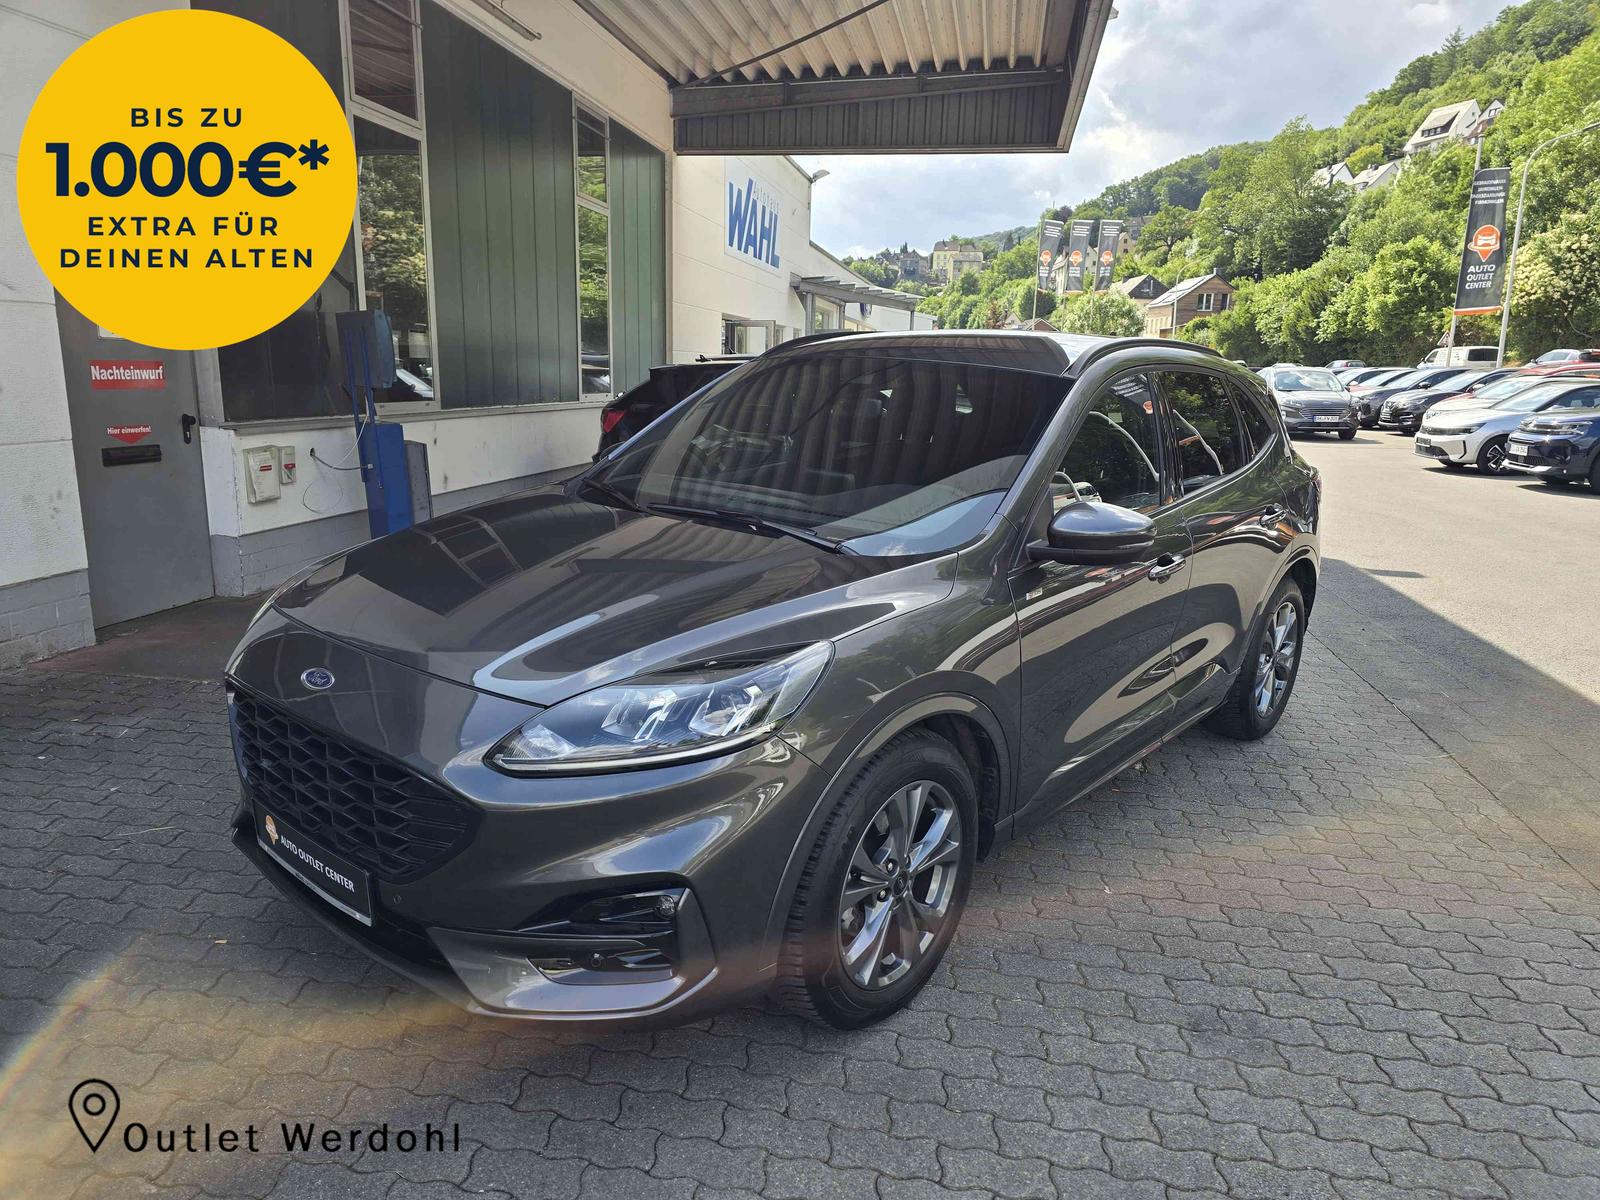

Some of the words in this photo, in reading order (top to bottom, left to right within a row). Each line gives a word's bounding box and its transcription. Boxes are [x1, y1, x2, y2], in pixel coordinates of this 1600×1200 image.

[728, 178, 779, 269] WAHL
[1467, 264, 1496, 273] AUTO
[1466, 272, 1494, 281] OUTLET
[1465, 281, 1492, 290] CENTER
[91, 365, 163, 380] Nachteinwurf
[121, 426, 151, 434] einwerfen!
[280, 835, 298, 855] AUTO
[298, 848, 324, 873] OUTLET
[325, 866, 355, 893] CENTER
